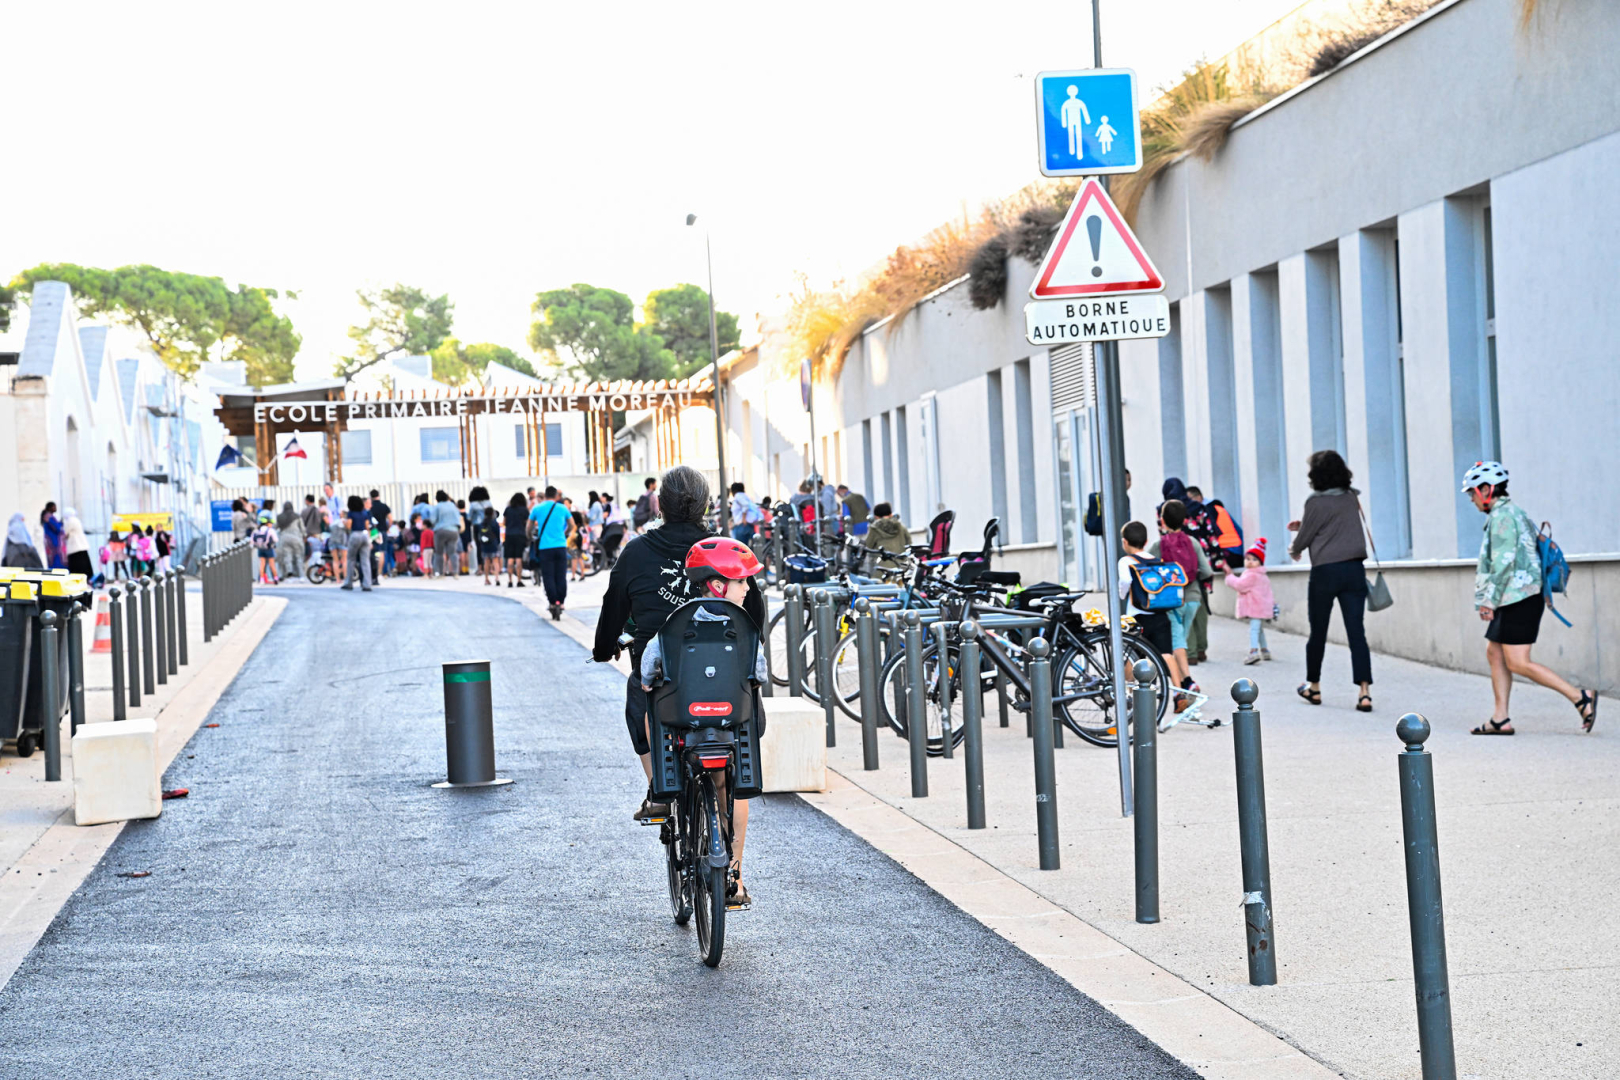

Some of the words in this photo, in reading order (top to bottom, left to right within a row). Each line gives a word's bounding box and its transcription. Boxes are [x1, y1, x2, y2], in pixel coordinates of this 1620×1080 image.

[1066, 301, 1129, 318] BORNE
[1033, 318, 1166, 340] AUTOMATIQUE
[348, 400, 468, 419] PRIMAIRE
[481, 396, 578, 414] JEANNE
[588, 393, 693, 411] MOREAU
